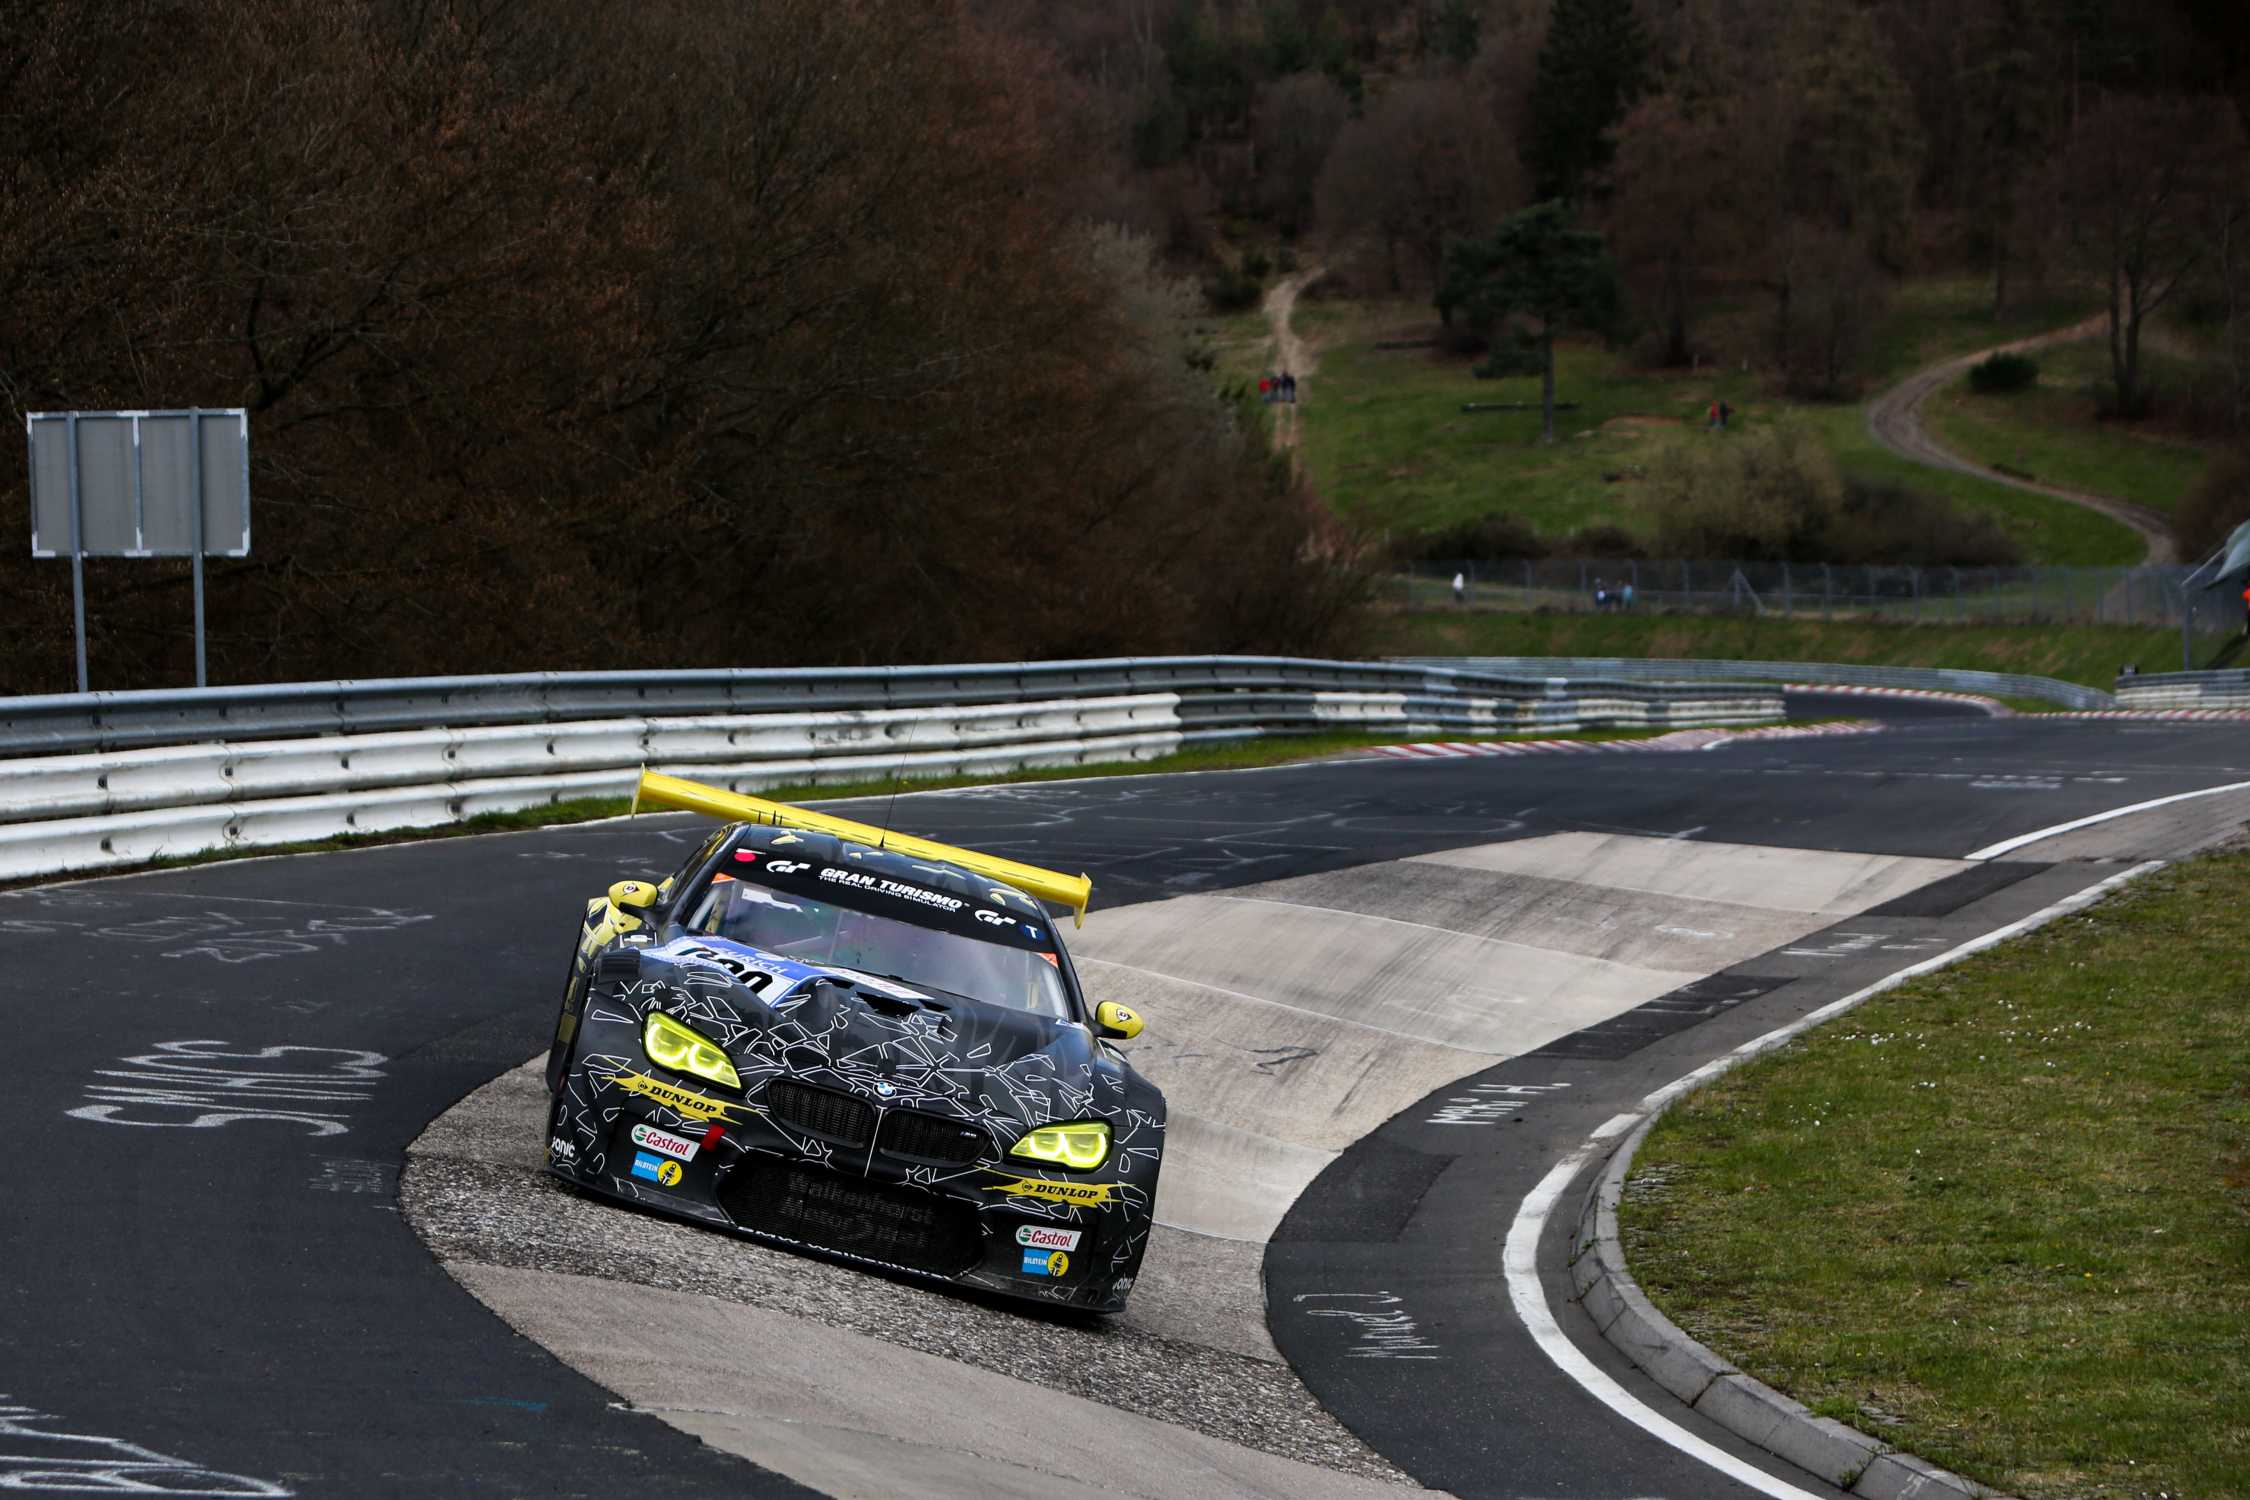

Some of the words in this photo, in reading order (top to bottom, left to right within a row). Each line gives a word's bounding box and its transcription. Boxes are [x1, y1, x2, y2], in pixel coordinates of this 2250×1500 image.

[818, 875, 836, 883] THE
[838, 880, 863, 889] REAL
[864, 884, 902, 897] DRIVING
[903, 894, 957, 913] SIMULATOR
[820, 867, 876, 885] GRAN
[879, 879, 963, 909] TURISMO
[649, 1085, 717, 1114] DUNLOP
[646, 1131, 690, 1156] Castrol
[634, 1158, 659, 1172] BILSTEIN
[1034, 1184, 1098, 1199] DUNLOP
[1031, 1229, 1073, 1248] Castrol
[1023, 1255, 1048, 1266] BILSTEIN
